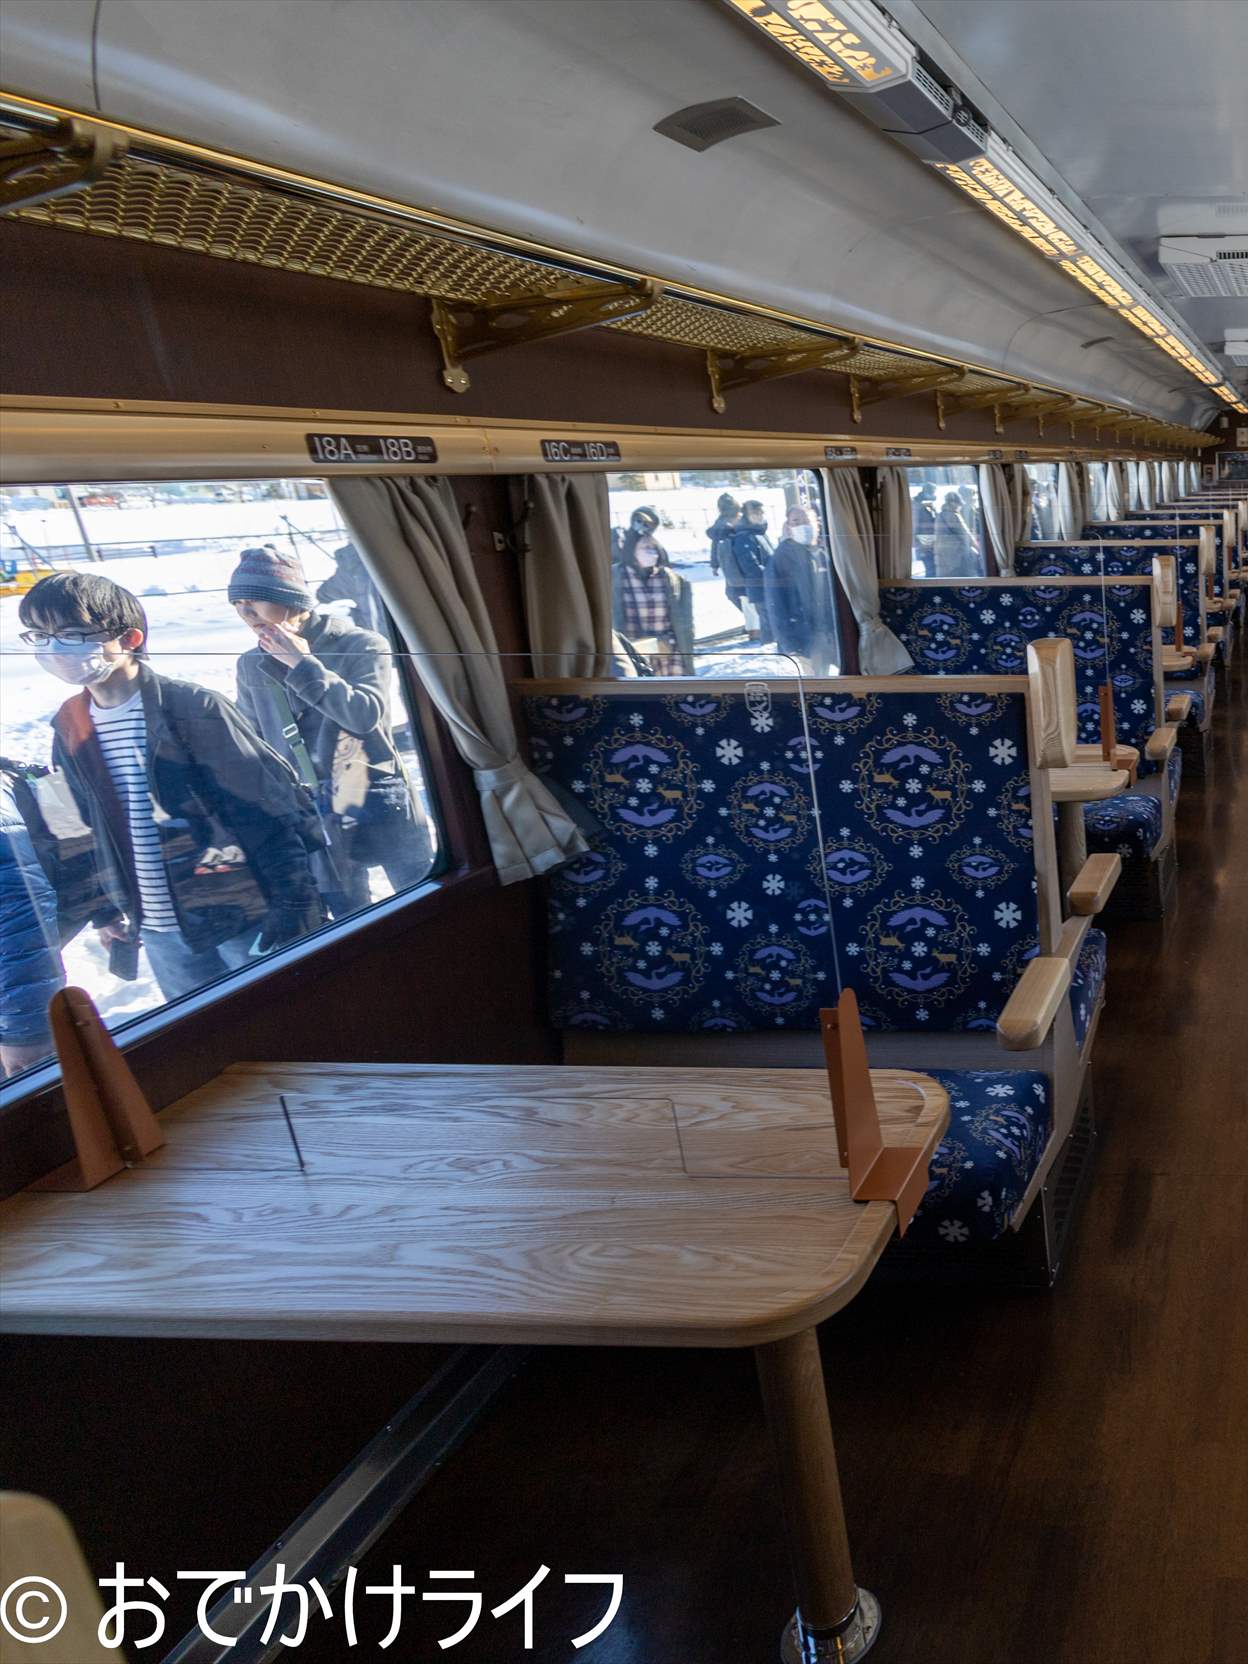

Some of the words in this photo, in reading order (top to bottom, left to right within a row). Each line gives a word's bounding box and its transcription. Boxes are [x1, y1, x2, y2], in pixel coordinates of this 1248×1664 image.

[313, 437, 356, 460] 18A
[379, 438, 416, 460] 18B
[544, 442, 571, 460] 16C
[584, 442, 608, 460] 16D
